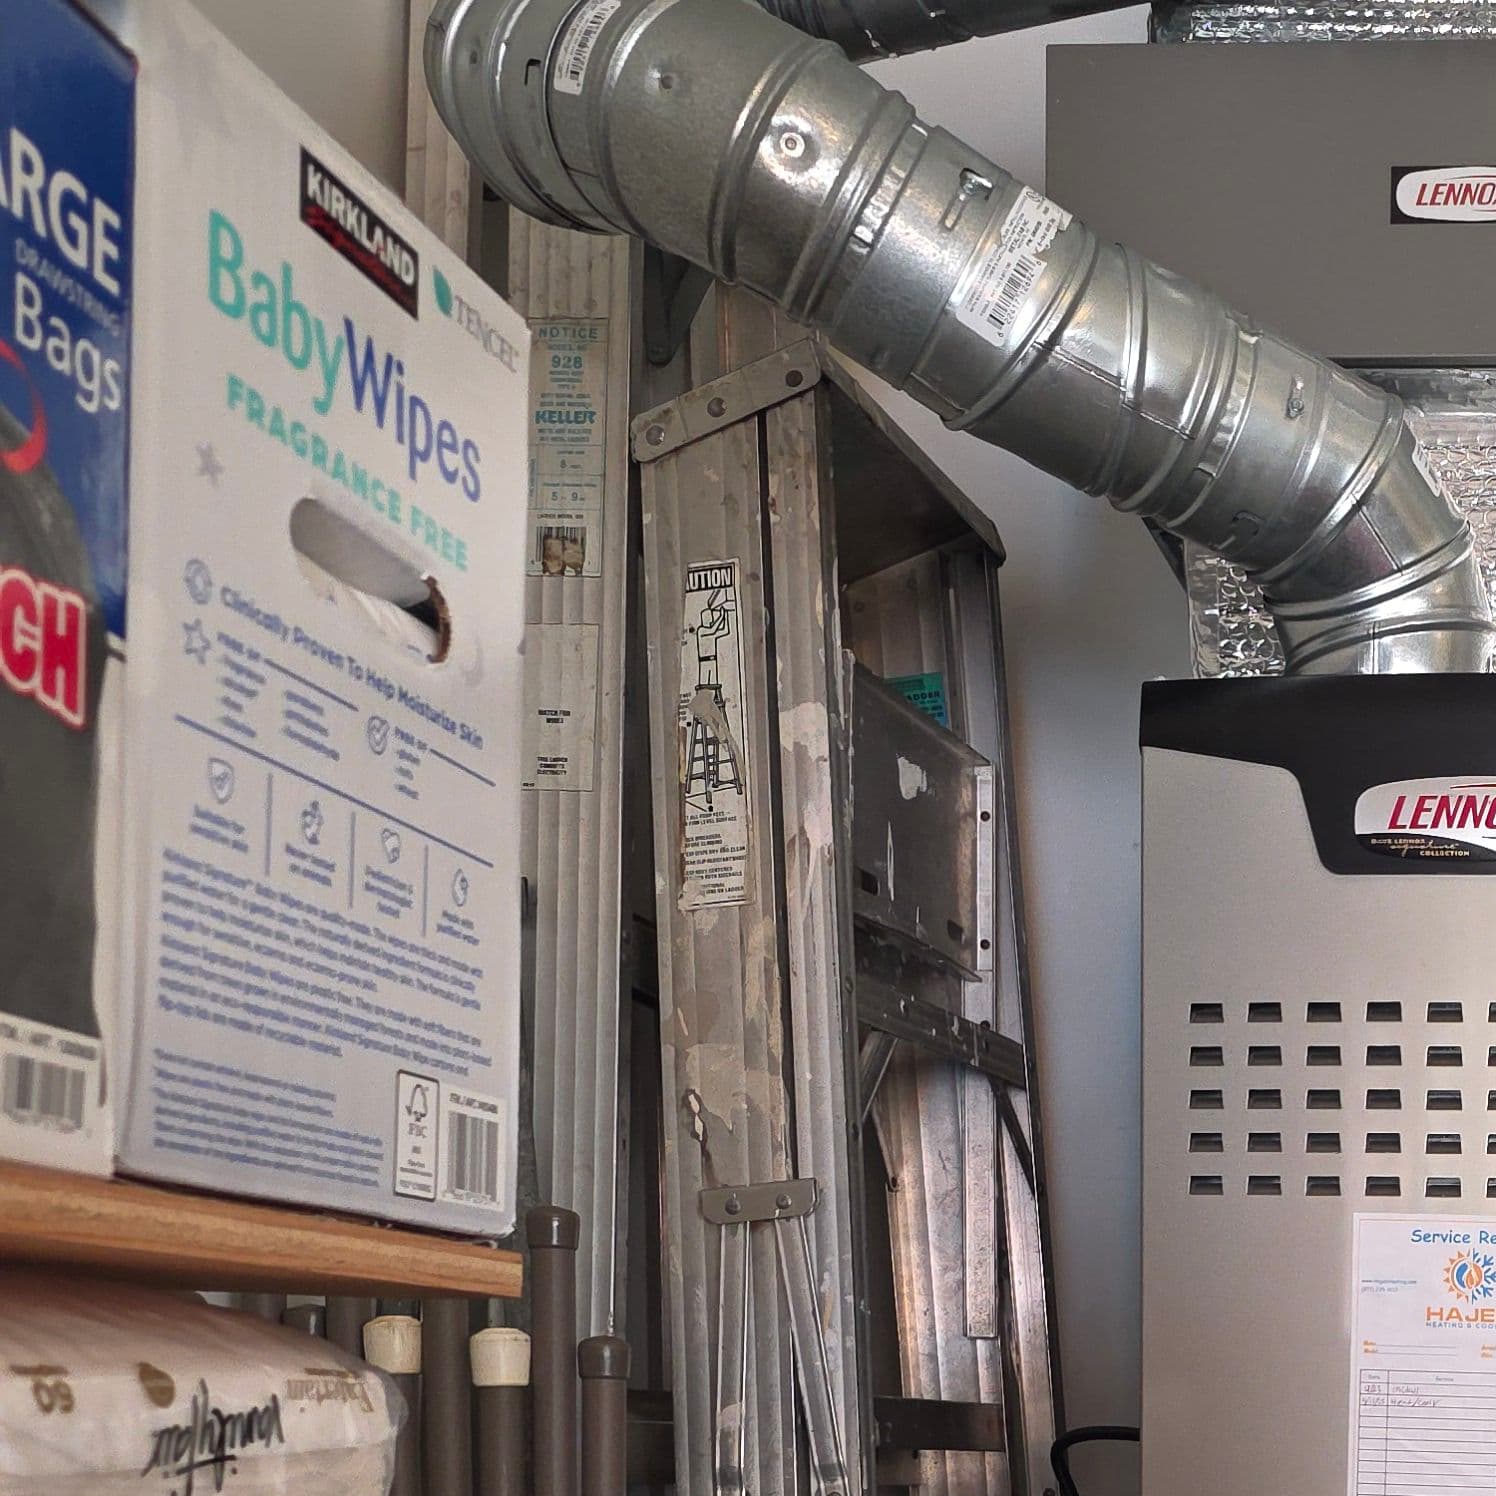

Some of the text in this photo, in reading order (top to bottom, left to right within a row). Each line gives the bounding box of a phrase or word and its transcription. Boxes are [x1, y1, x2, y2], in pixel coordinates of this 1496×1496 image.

[0, 127, 122, 297] RGE
[306, 163, 415, 286] KIRKLAND
[14, 270, 122, 414] Bags
[538, 326, 599, 340] NOTICE
[551, 354, 583, 369] 928
[225, 372, 470, 571] FRAGRANCE FREE
[535, 409, 597, 425] KELLER
[220, 585, 484, 750] Clinically Proven To Help Moisturize Skin
[1410, 1229, 1471, 1246] Service
